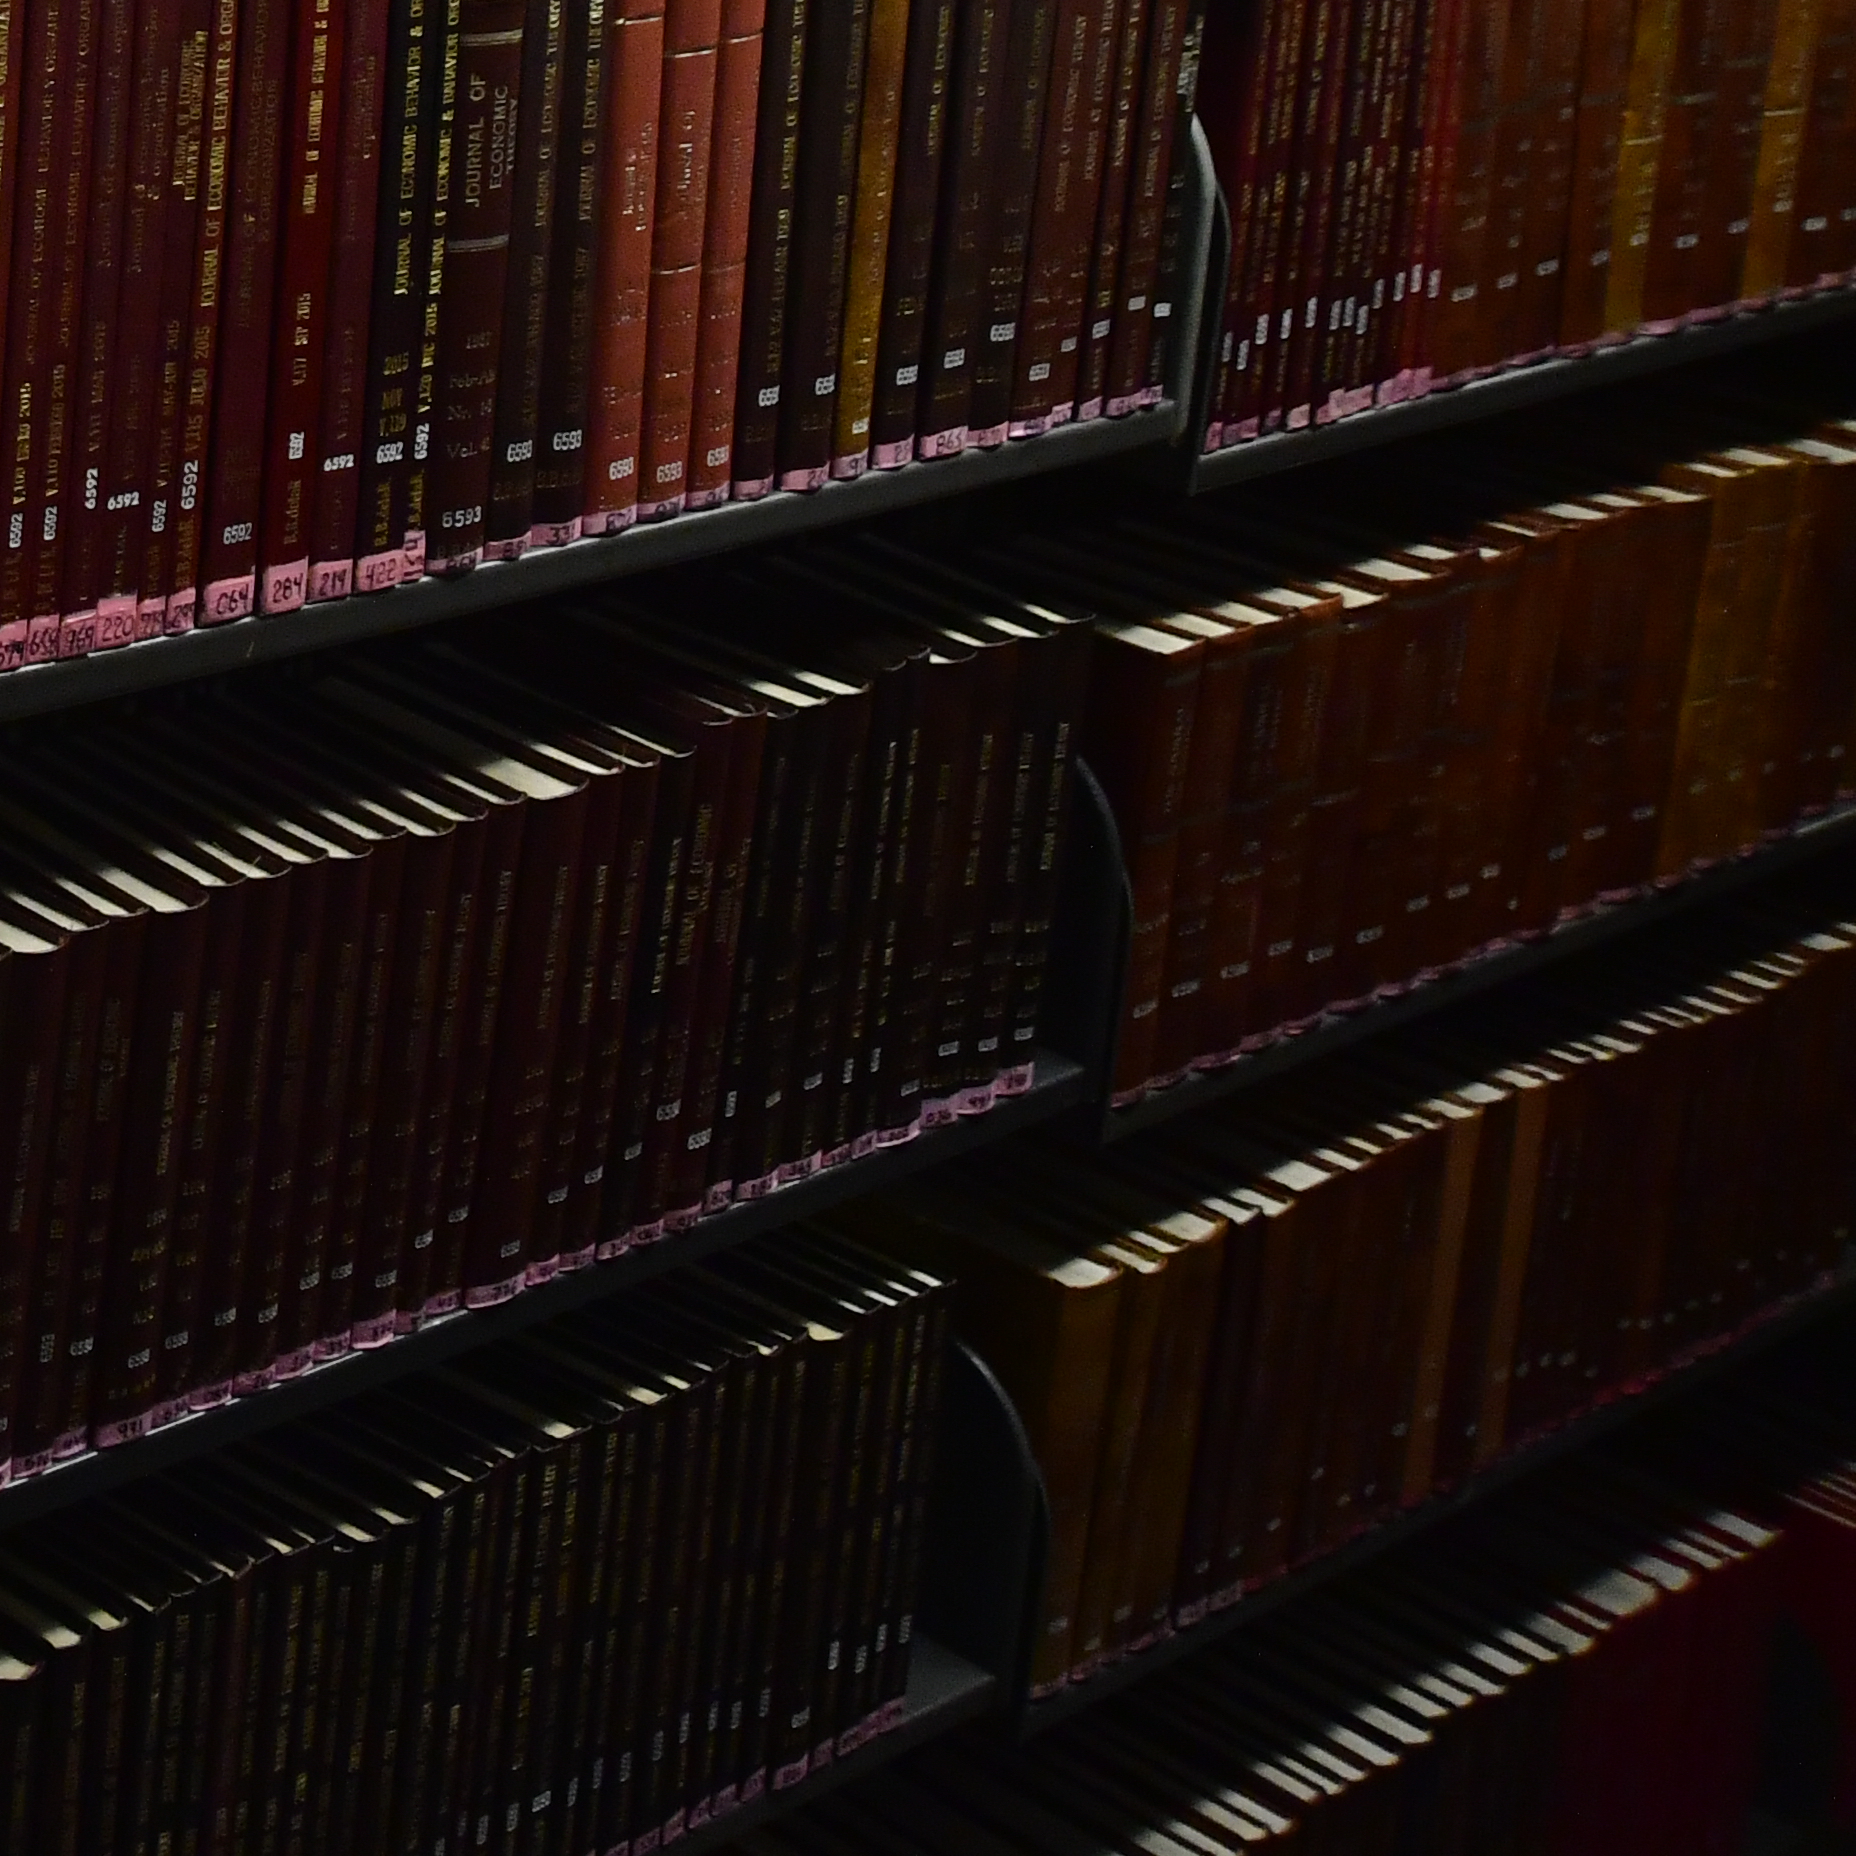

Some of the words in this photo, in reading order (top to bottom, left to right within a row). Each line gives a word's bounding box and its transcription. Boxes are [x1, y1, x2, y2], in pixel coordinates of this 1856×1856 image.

[409, 25, 424, 37] &
[405, 47, 423, 117] BEHAVIOR
[469, 72, 487, 101] OF
[400, 125, 418, 199] ECONOMIC
[489, 86, 509, 190] ECONOMIC
[465, 117, 485, 208] JOURNAL
[399, 208, 413, 225] OF
[393, 234, 413, 295] JOURNAL
[415, 423, 430, 459] 6592
[441, 506, 482, 528] 6593
